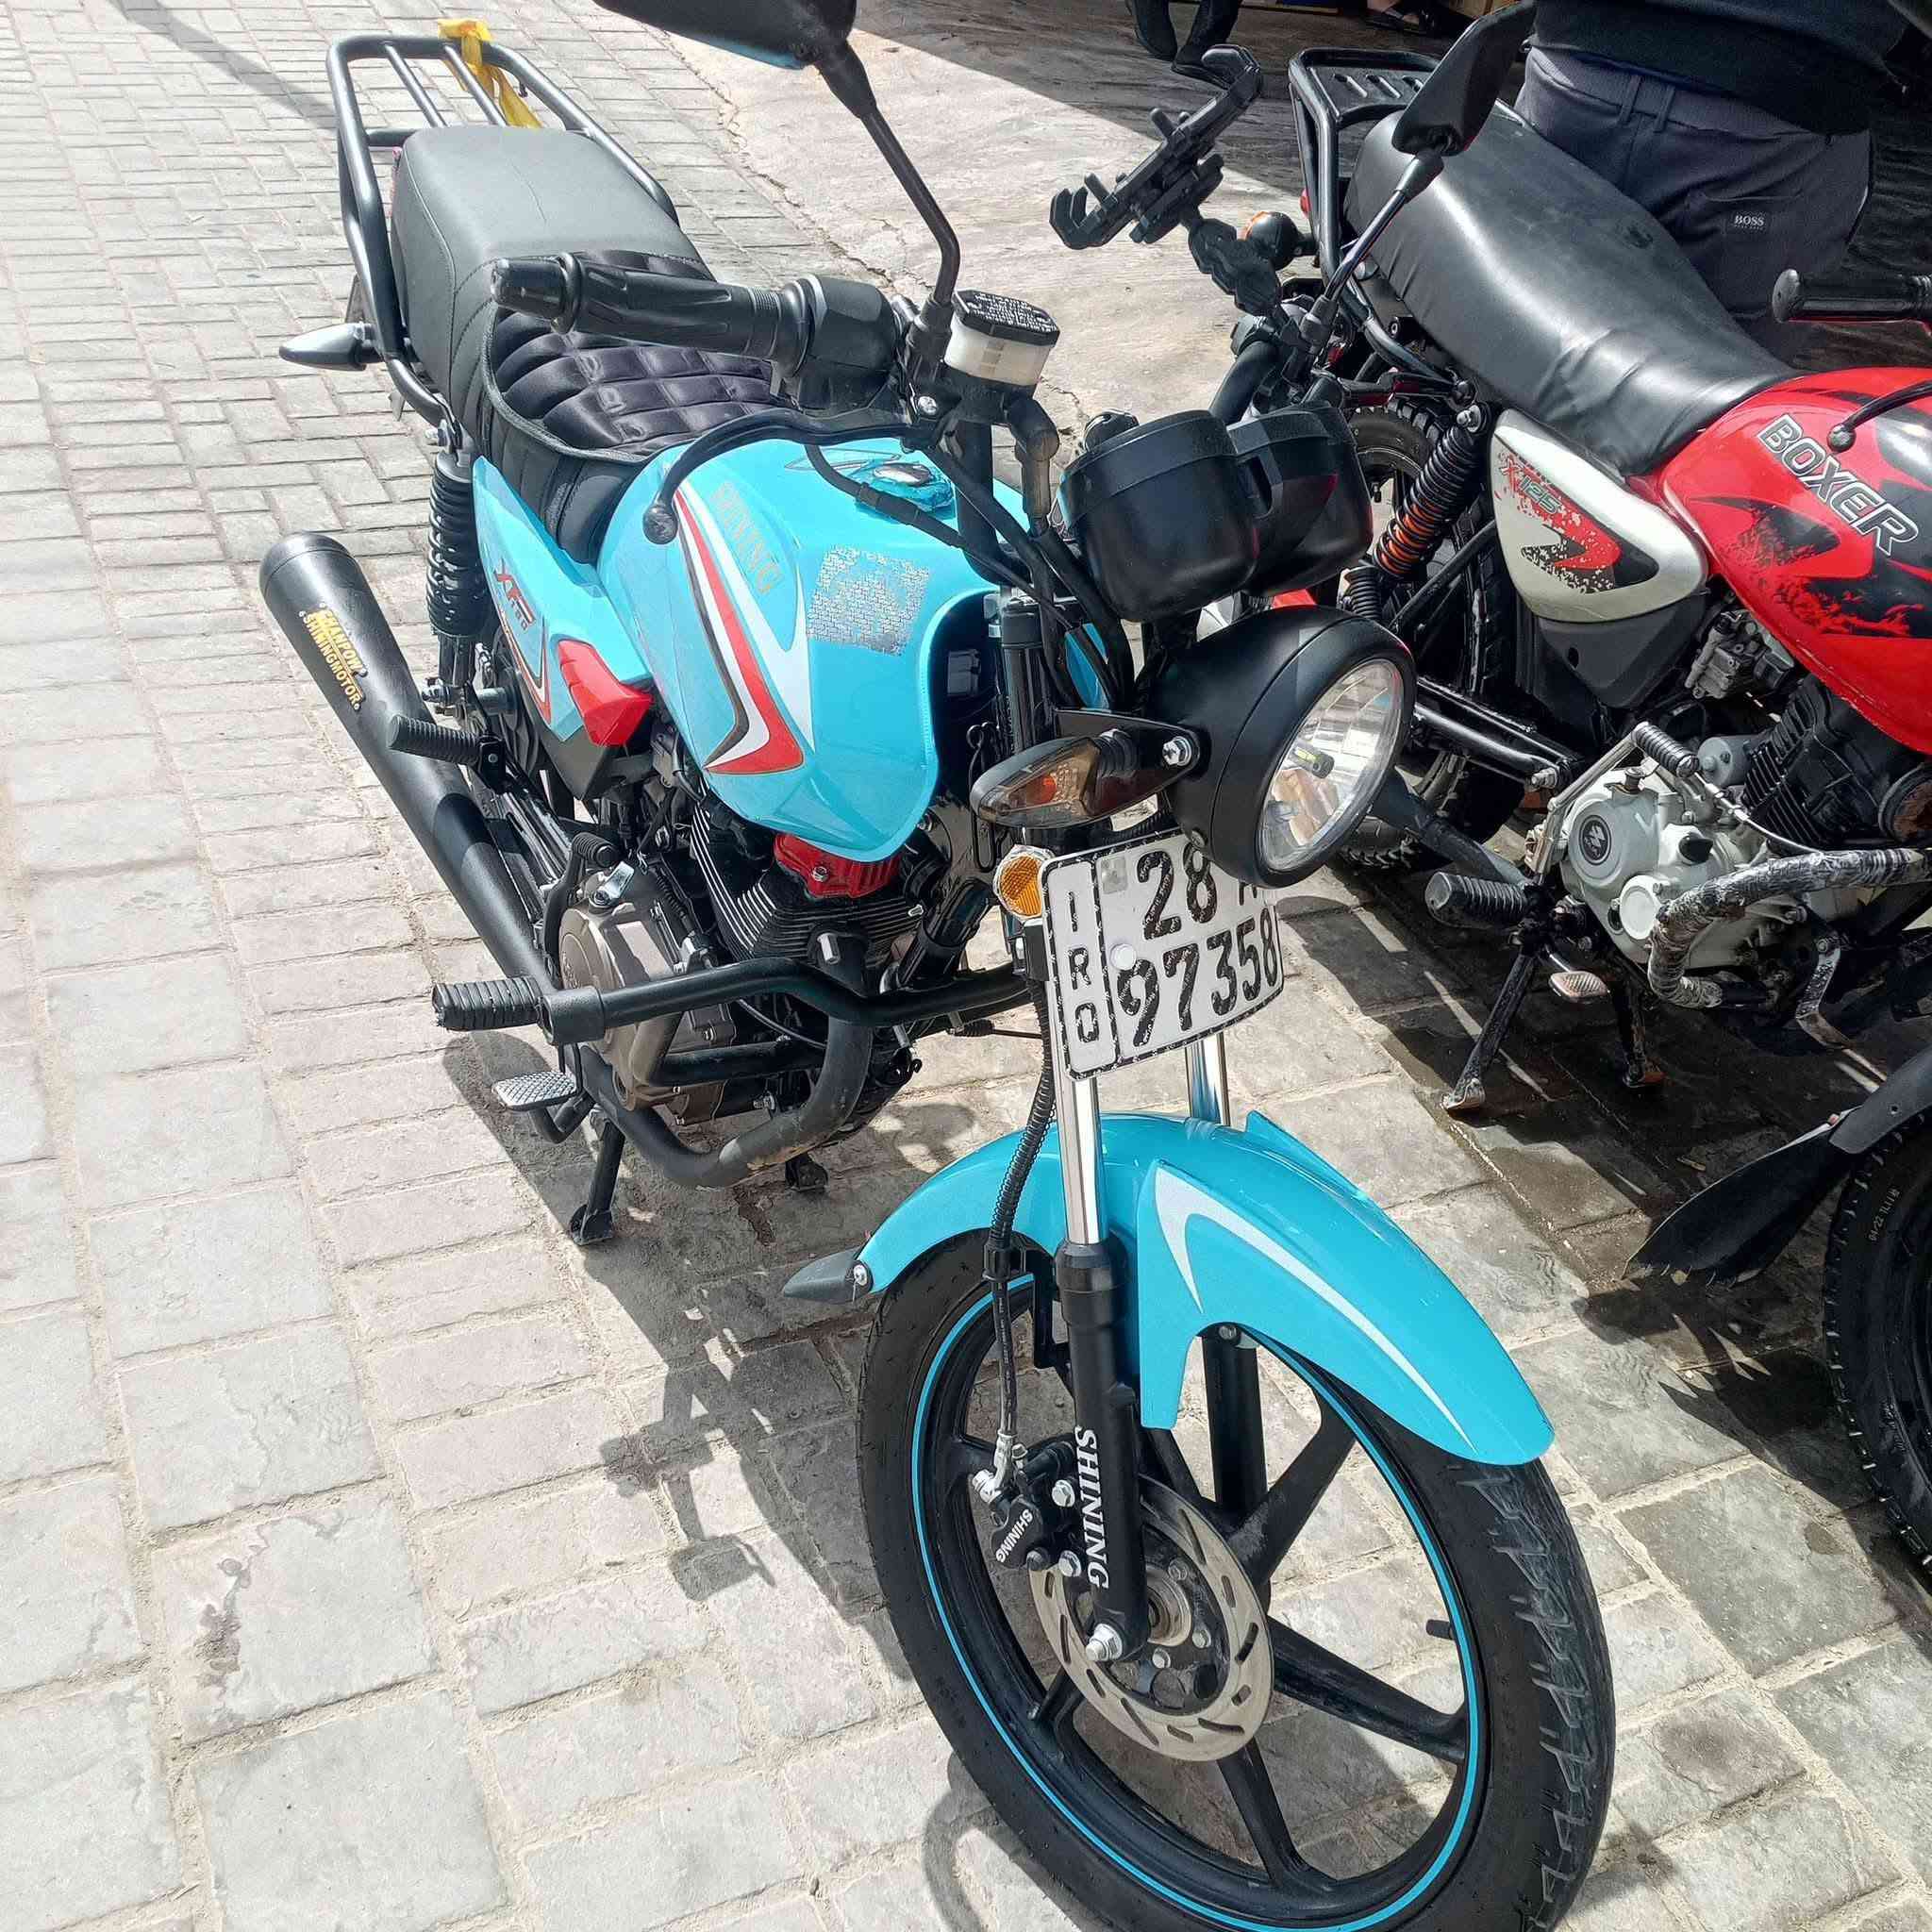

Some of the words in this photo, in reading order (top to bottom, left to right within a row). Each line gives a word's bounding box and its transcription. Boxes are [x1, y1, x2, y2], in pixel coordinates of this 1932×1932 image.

[1734, 214, 1765, 226] BOSS
[1756, 413, 1919, 557] BOXER
[1137, 841, 1218, 941] 28
[1117, 908, 1278, 1047] 97358
[995, 1508, 1034, 1563] SHINING
[1074, 1424, 1109, 1590] SHINING
